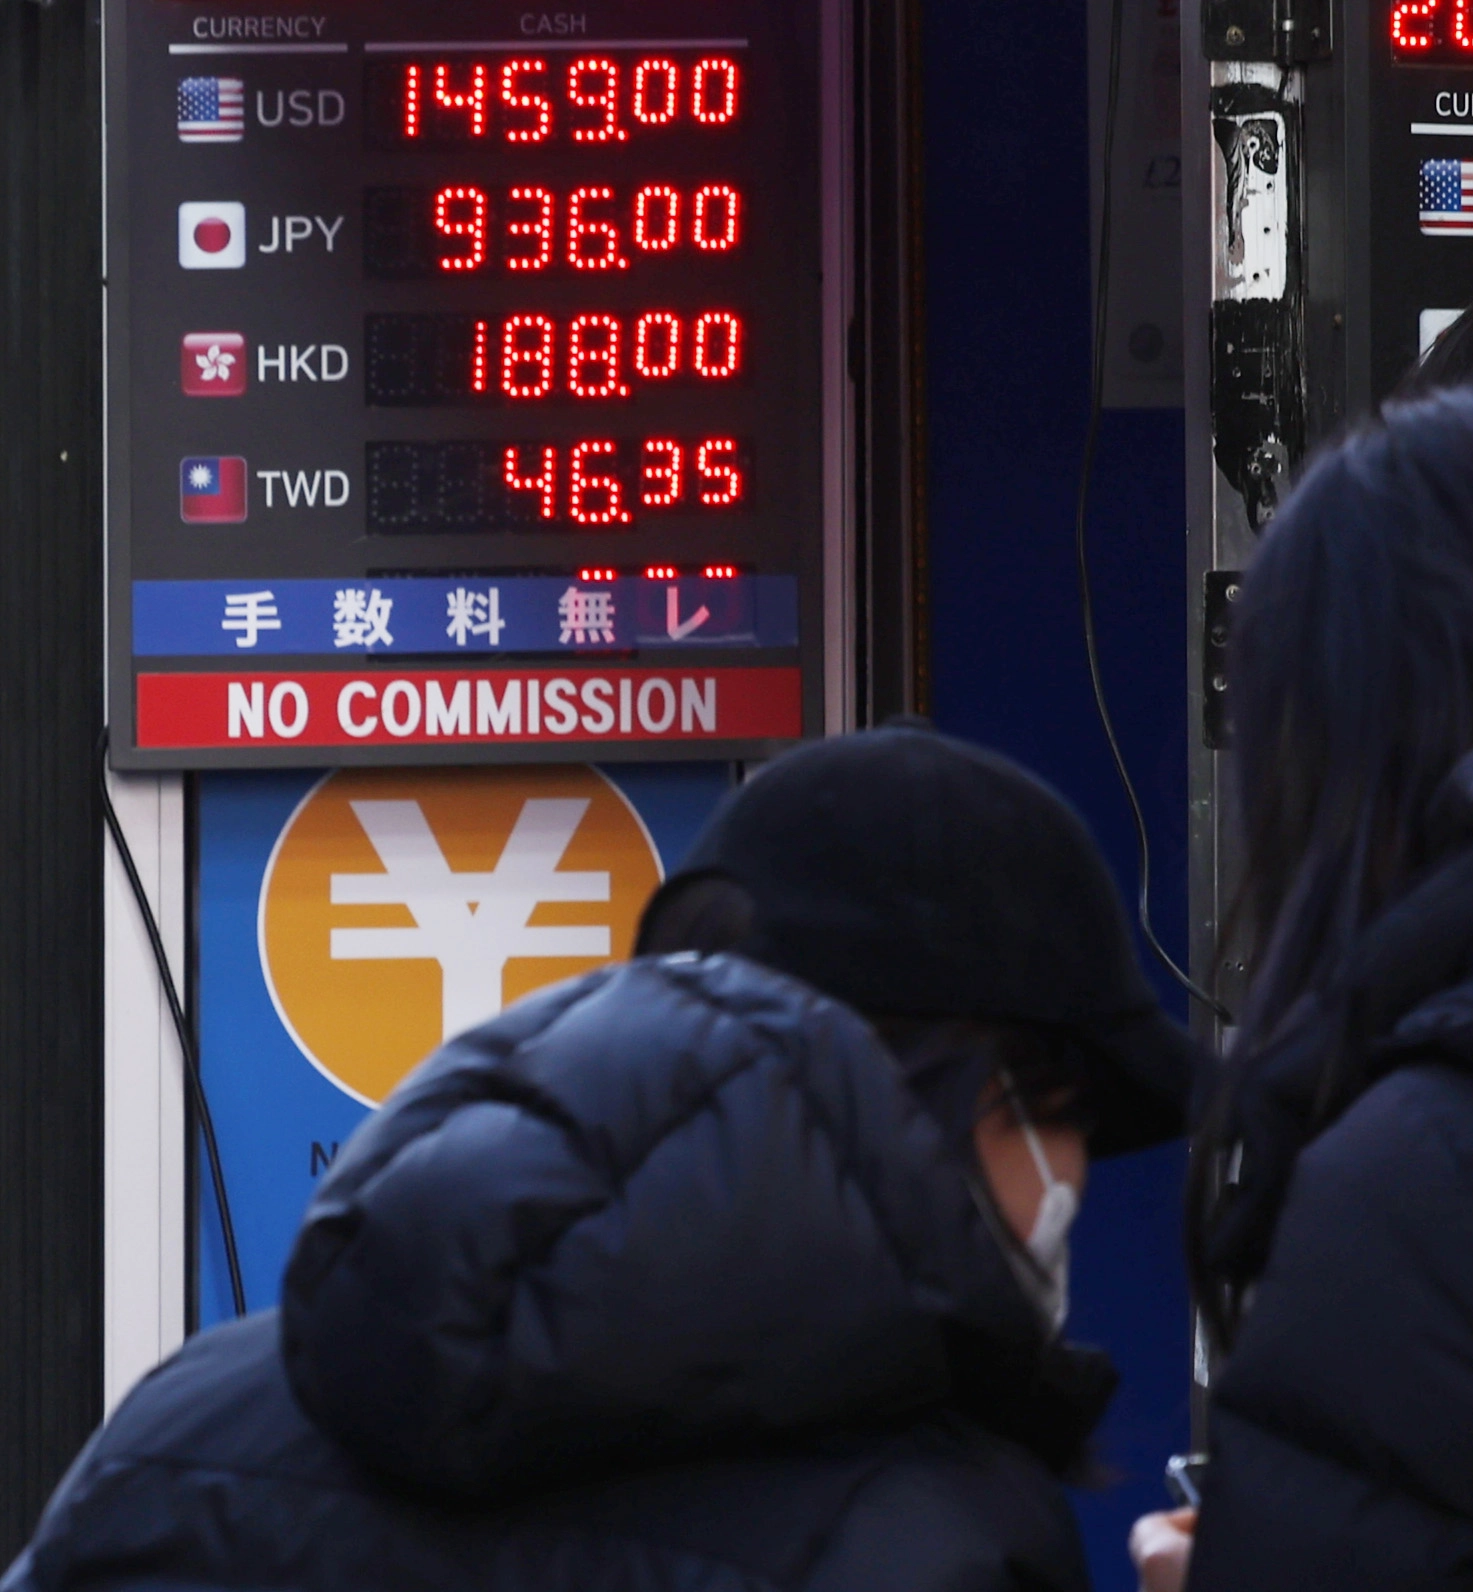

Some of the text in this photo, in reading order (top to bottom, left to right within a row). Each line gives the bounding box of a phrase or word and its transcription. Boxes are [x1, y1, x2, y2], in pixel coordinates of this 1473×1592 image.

[192, 16, 325, 39] CURRENCY
[520, 13, 586, 34] CASH
[256, 56, 740, 144] USD 1459.00
[258, 183, 742, 273] JPY 936.00
[258, 310, 743, 399] HKD 188.00
[256, 437, 743, 525] TWD 46.35
[228, 678, 715, 738] NO COMMISSION
